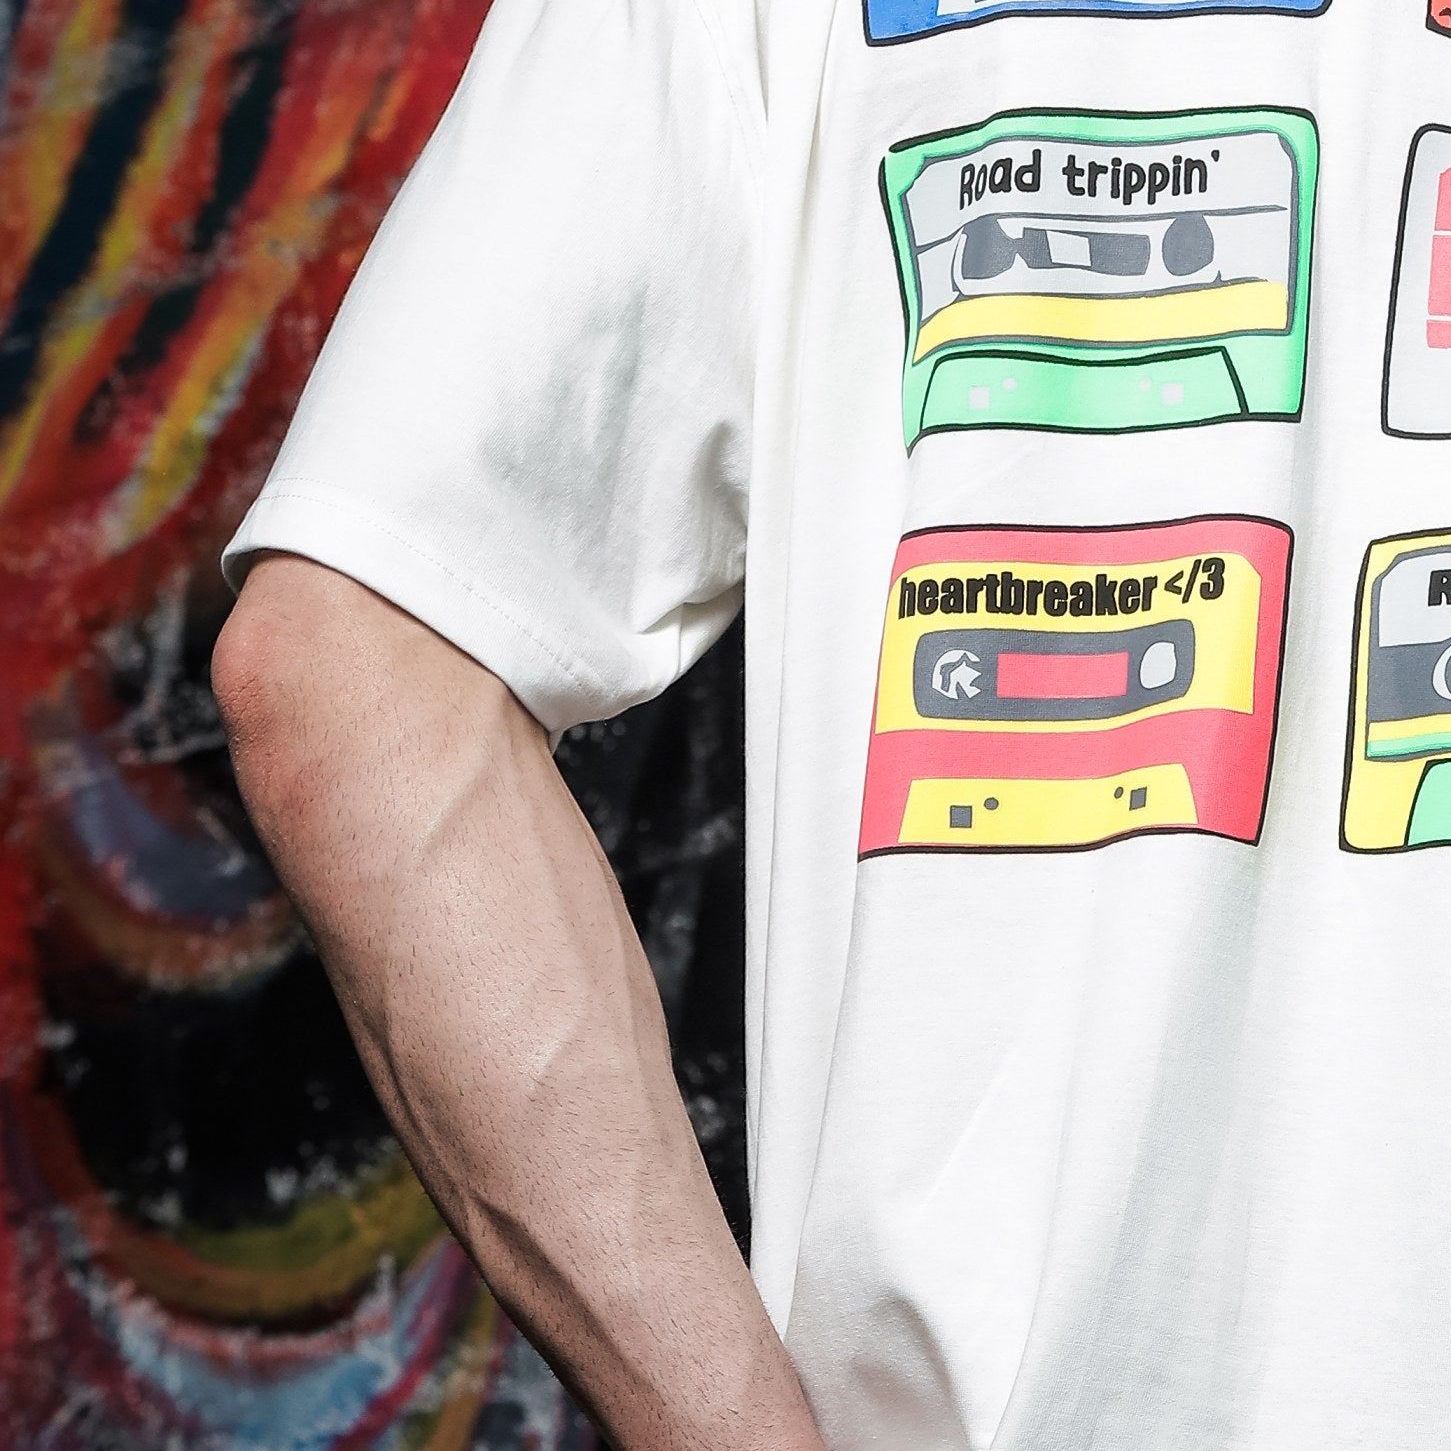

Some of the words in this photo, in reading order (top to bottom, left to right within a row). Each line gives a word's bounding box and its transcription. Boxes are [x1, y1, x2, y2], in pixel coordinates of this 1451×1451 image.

[960, 149, 1041, 210] Road
[1062, 150, 1220, 205] trippin'
[898, 571, 1158, 619] heartbreaker
[1164, 557, 1226, 603] </3
